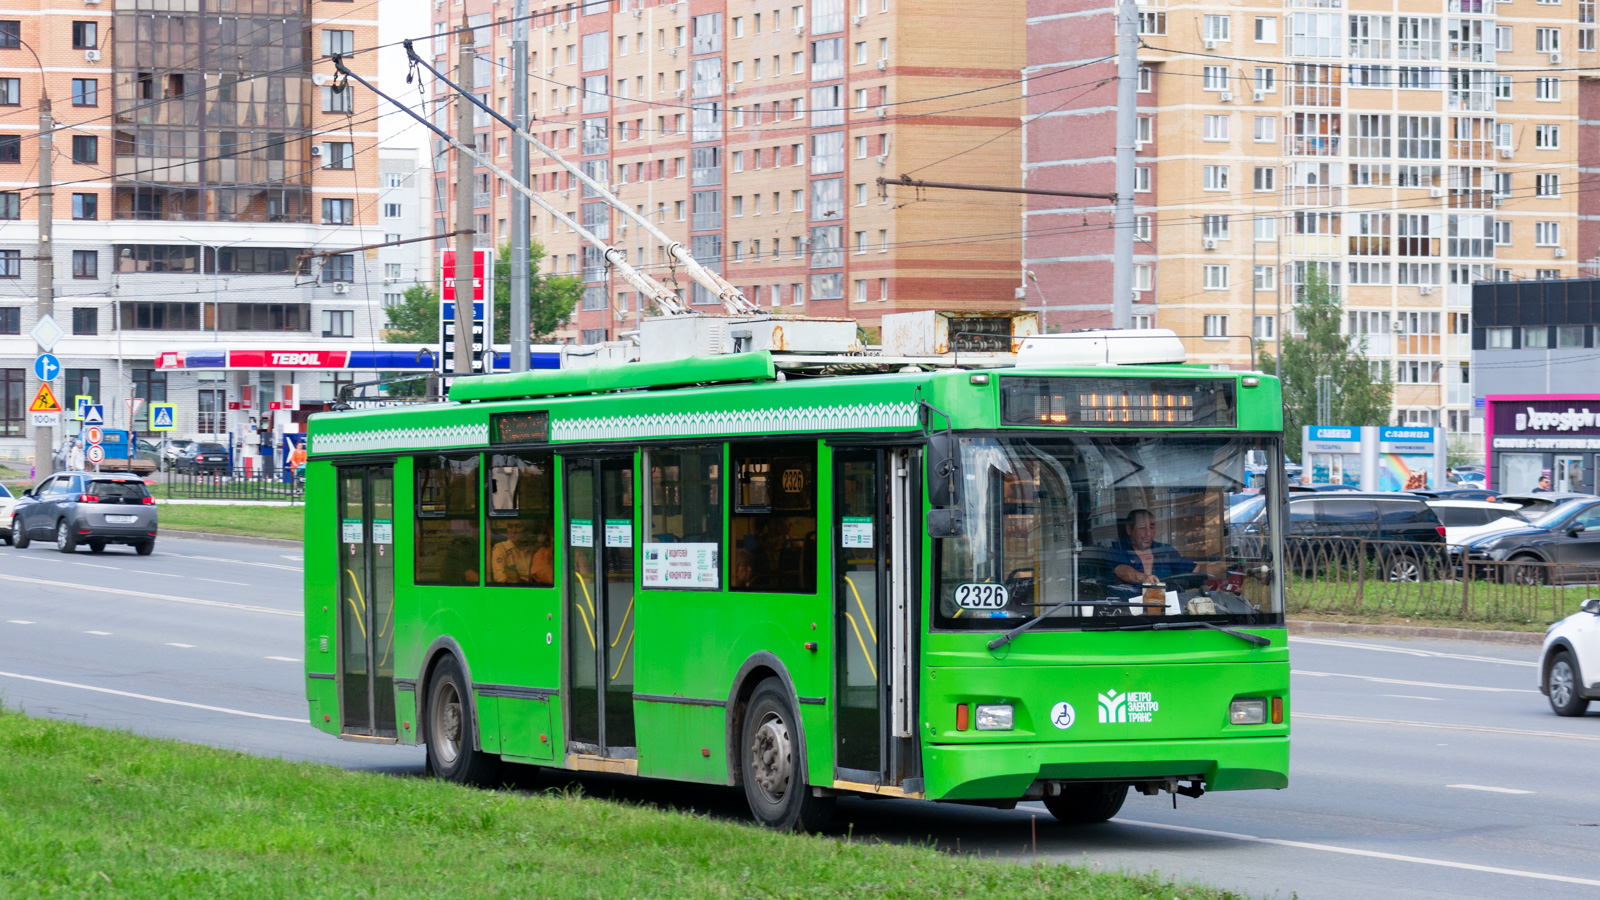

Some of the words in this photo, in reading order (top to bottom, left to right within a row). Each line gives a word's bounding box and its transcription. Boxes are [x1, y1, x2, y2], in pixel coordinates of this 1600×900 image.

[271, 352, 321, 365] TEBOIL
[1317, 429, 1352, 439] славица
[1385, 430, 1430, 439] славица
[93, 450, 99, 459] 5
[784, 471, 802, 491] 2326
[960, 586, 1004, 607] 2326
[1127, 692, 1152, 702] МЕТРО
[1127, 702, 1159, 712] ЭЛЕКТРО
[1128, 712, 1152, 723] ТРАНС
